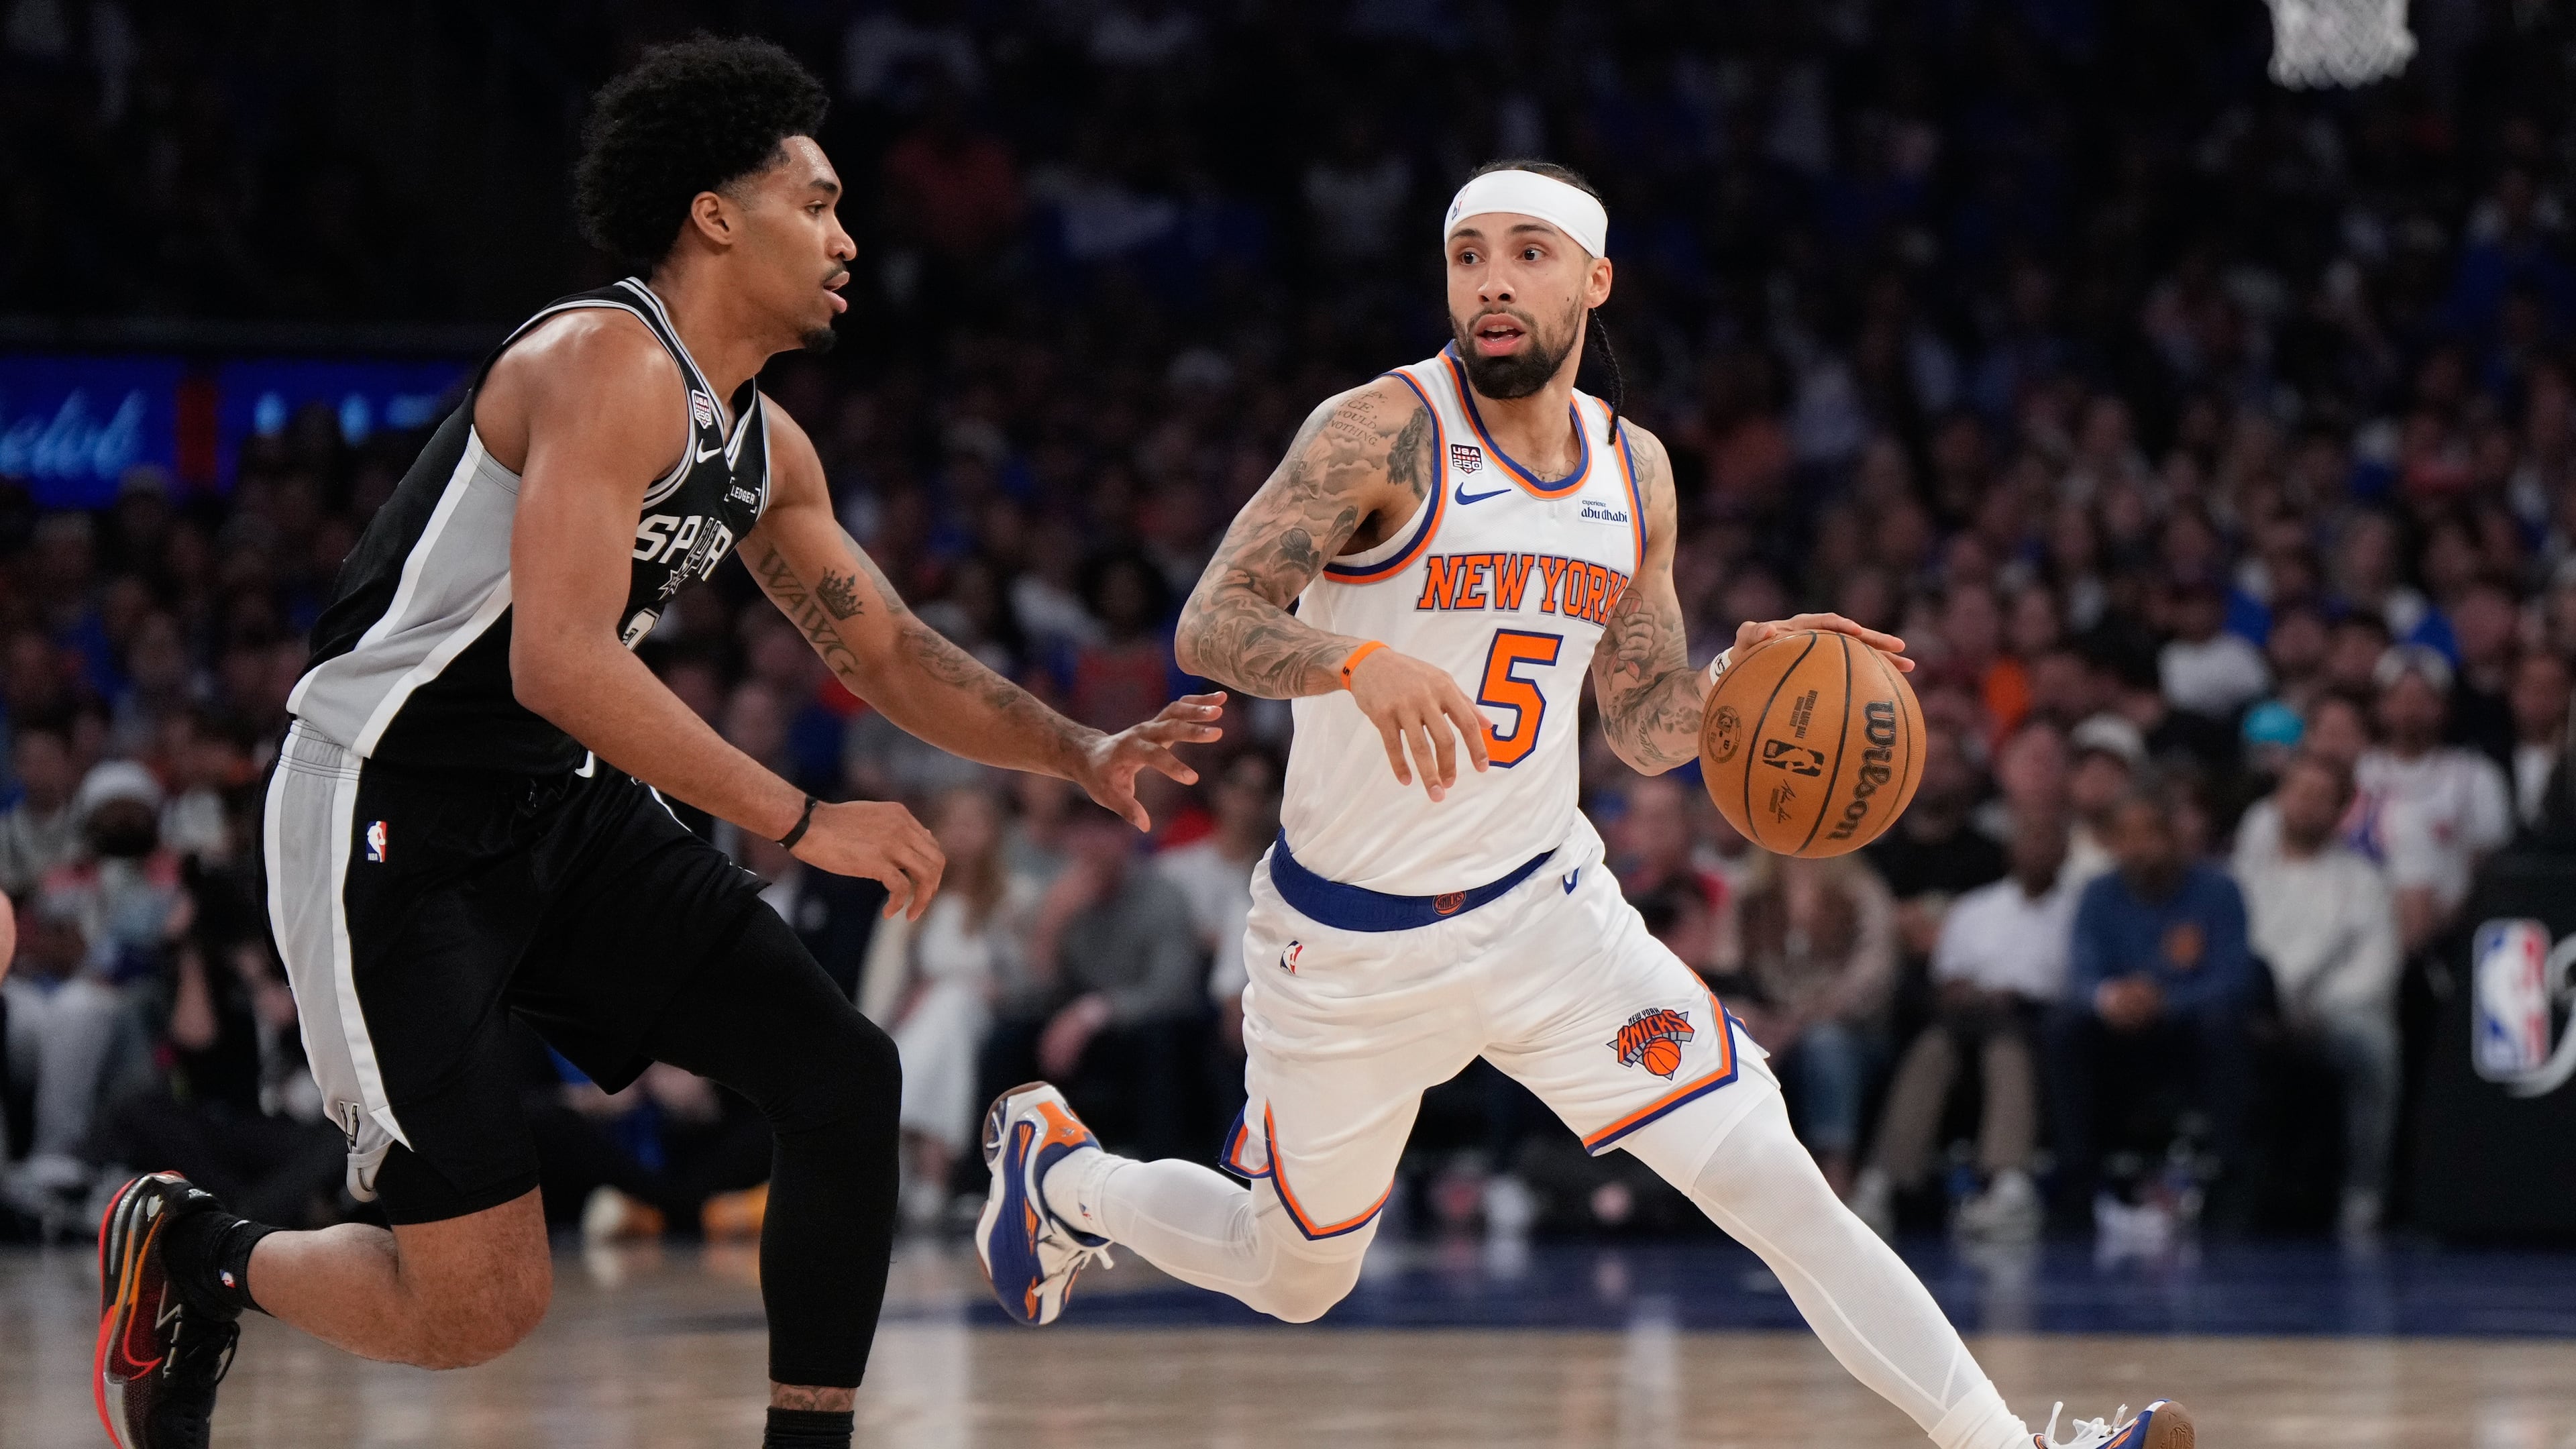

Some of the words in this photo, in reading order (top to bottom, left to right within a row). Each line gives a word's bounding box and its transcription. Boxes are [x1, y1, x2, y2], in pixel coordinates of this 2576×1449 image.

[694, 395, 708, 407] USA
[696, 409, 710, 421] 250
[1452, 446, 1479, 457] USA
[1453, 458, 1482, 470] 250
[730, 484, 755, 505] LEDGER
[1582, 499, 1606, 508] experience
[1581, 506, 1600, 519] abu
[1601, 509, 1627, 523] dhabi
[1413, 551, 1535, 612] NEW
[1536, 553, 1630, 628] YORK
[1476, 629, 1564, 769] 5
[368, 853, 378, 861] NBA
[1628, 1012, 1642, 1025] NEW
[1642, 1008, 1661, 1017] YORK
[1617, 1009, 1695, 1065] KNICKS
